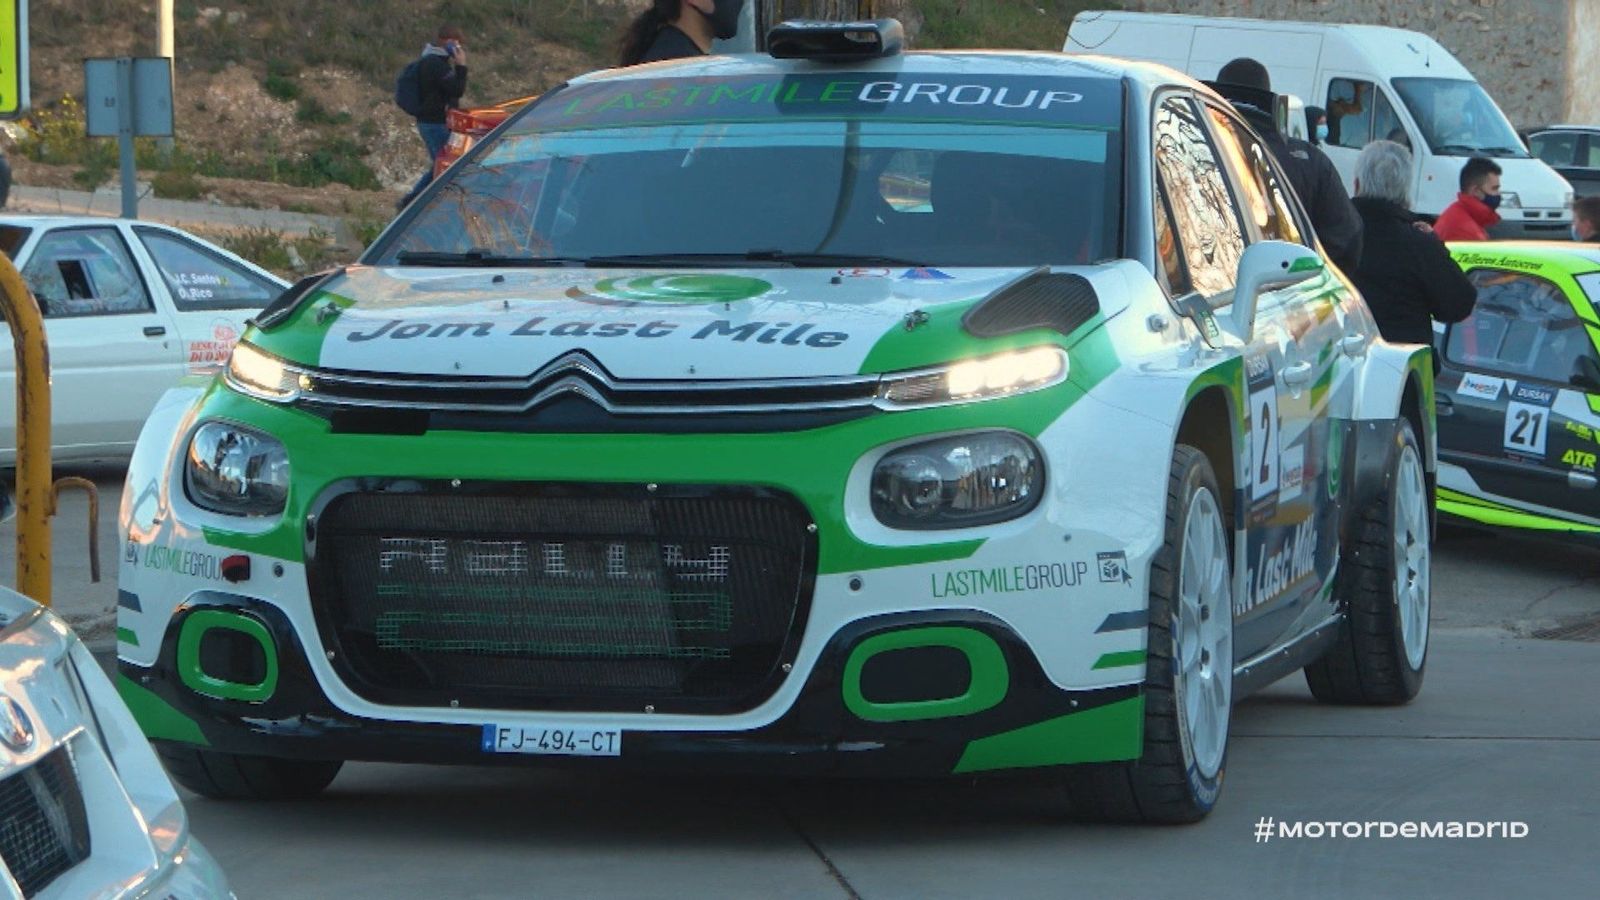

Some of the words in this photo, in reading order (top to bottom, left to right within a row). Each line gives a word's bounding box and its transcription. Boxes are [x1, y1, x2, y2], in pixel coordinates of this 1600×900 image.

[562, 81, 1084, 116] LASTMILEGROUP
[346, 319, 496, 343] Jom
[510, 316, 680, 340] Last
[691, 318, 849, 348] Mile
[1259, 401, 1271, 485] 2
[1510, 408, 1544, 447] 21
[1561, 449, 1597, 469] ATR
[931, 561, 1088, 599] LASTMILEGROUP
[1255, 536, 1291, 605] Last
[498, 728, 617, 753] FJ-494-CT
